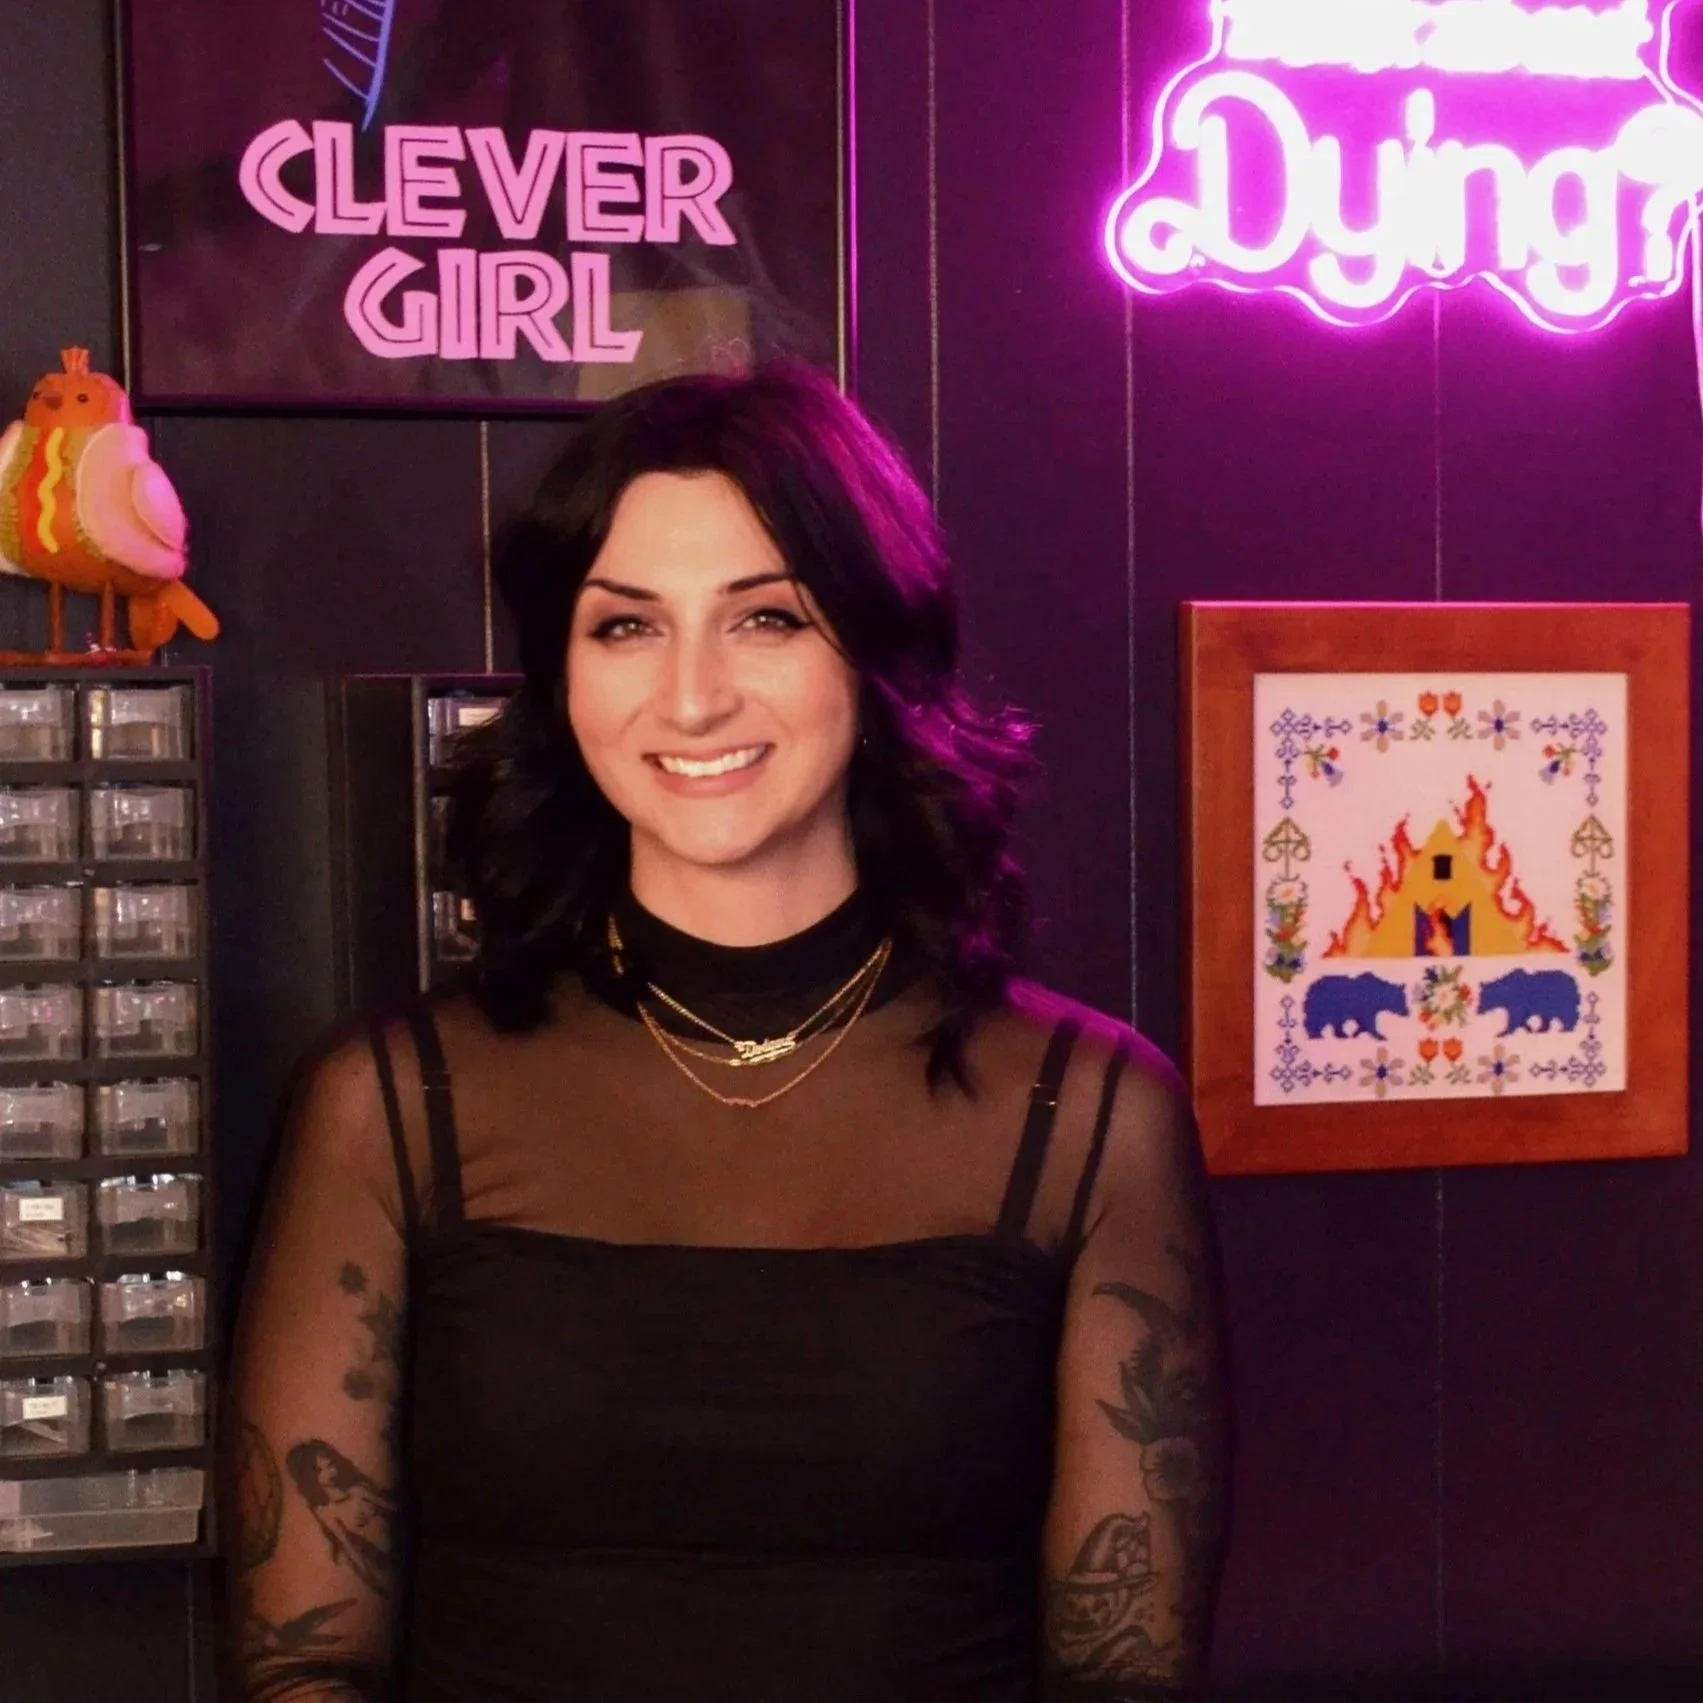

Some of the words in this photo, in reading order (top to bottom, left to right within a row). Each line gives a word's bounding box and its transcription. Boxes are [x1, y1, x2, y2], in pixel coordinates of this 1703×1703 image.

[238, 119, 737, 246] CLEVER
[1121, 70, 1703, 317] Dying?
[344, 246, 643, 363] GIRL
